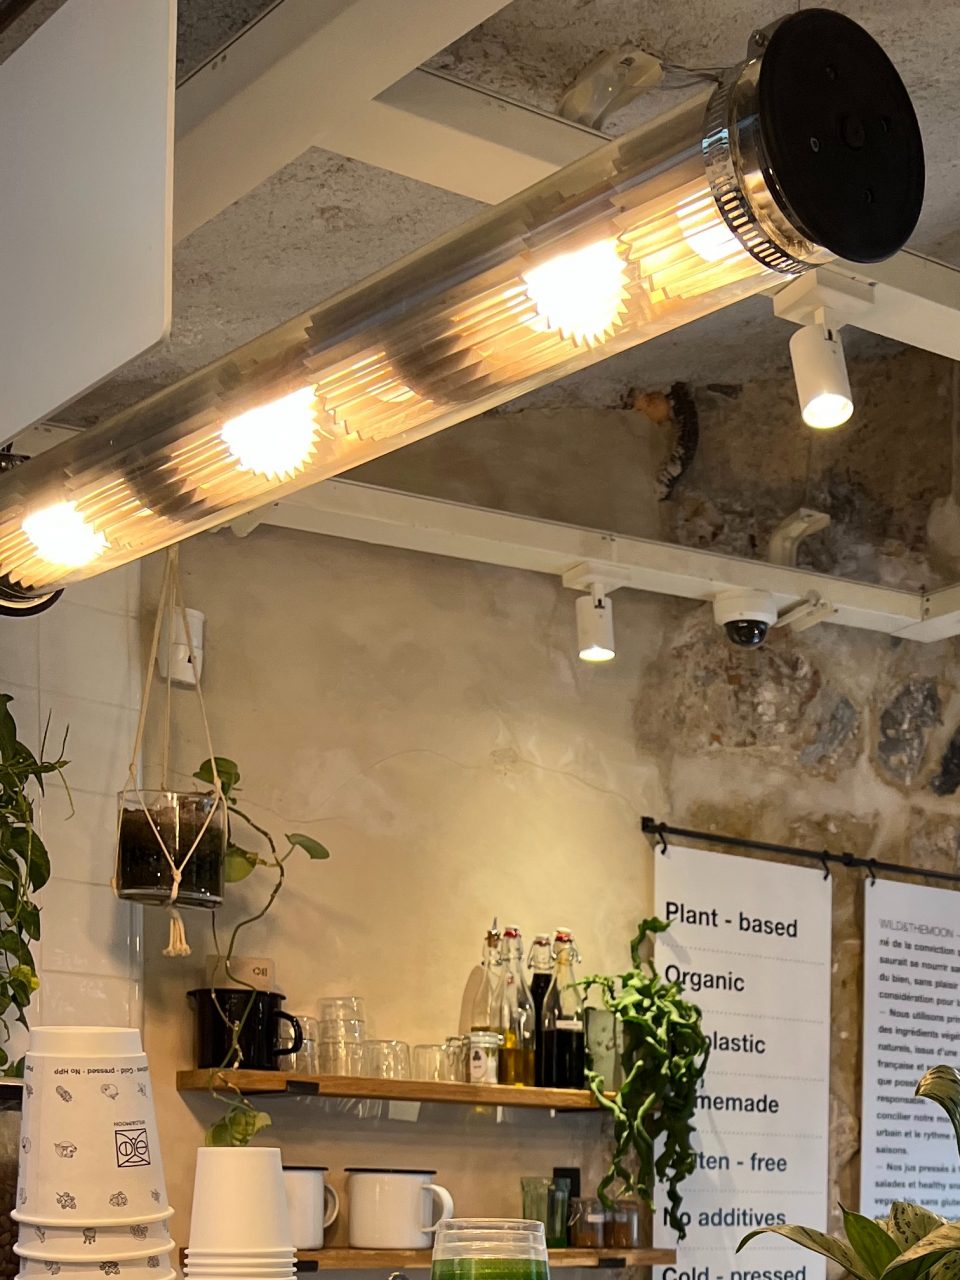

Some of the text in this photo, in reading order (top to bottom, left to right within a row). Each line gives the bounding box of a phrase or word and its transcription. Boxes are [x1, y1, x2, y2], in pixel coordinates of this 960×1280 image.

[665, 901, 718, 928] Plant
[739, 911, 798, 938] based
[665, 964, 745, 992] Organic
[694, 1093, 780, 1114] memade
[751, 1152, 788, 1172] free
[663, 1206, 787, 1227] No additives
